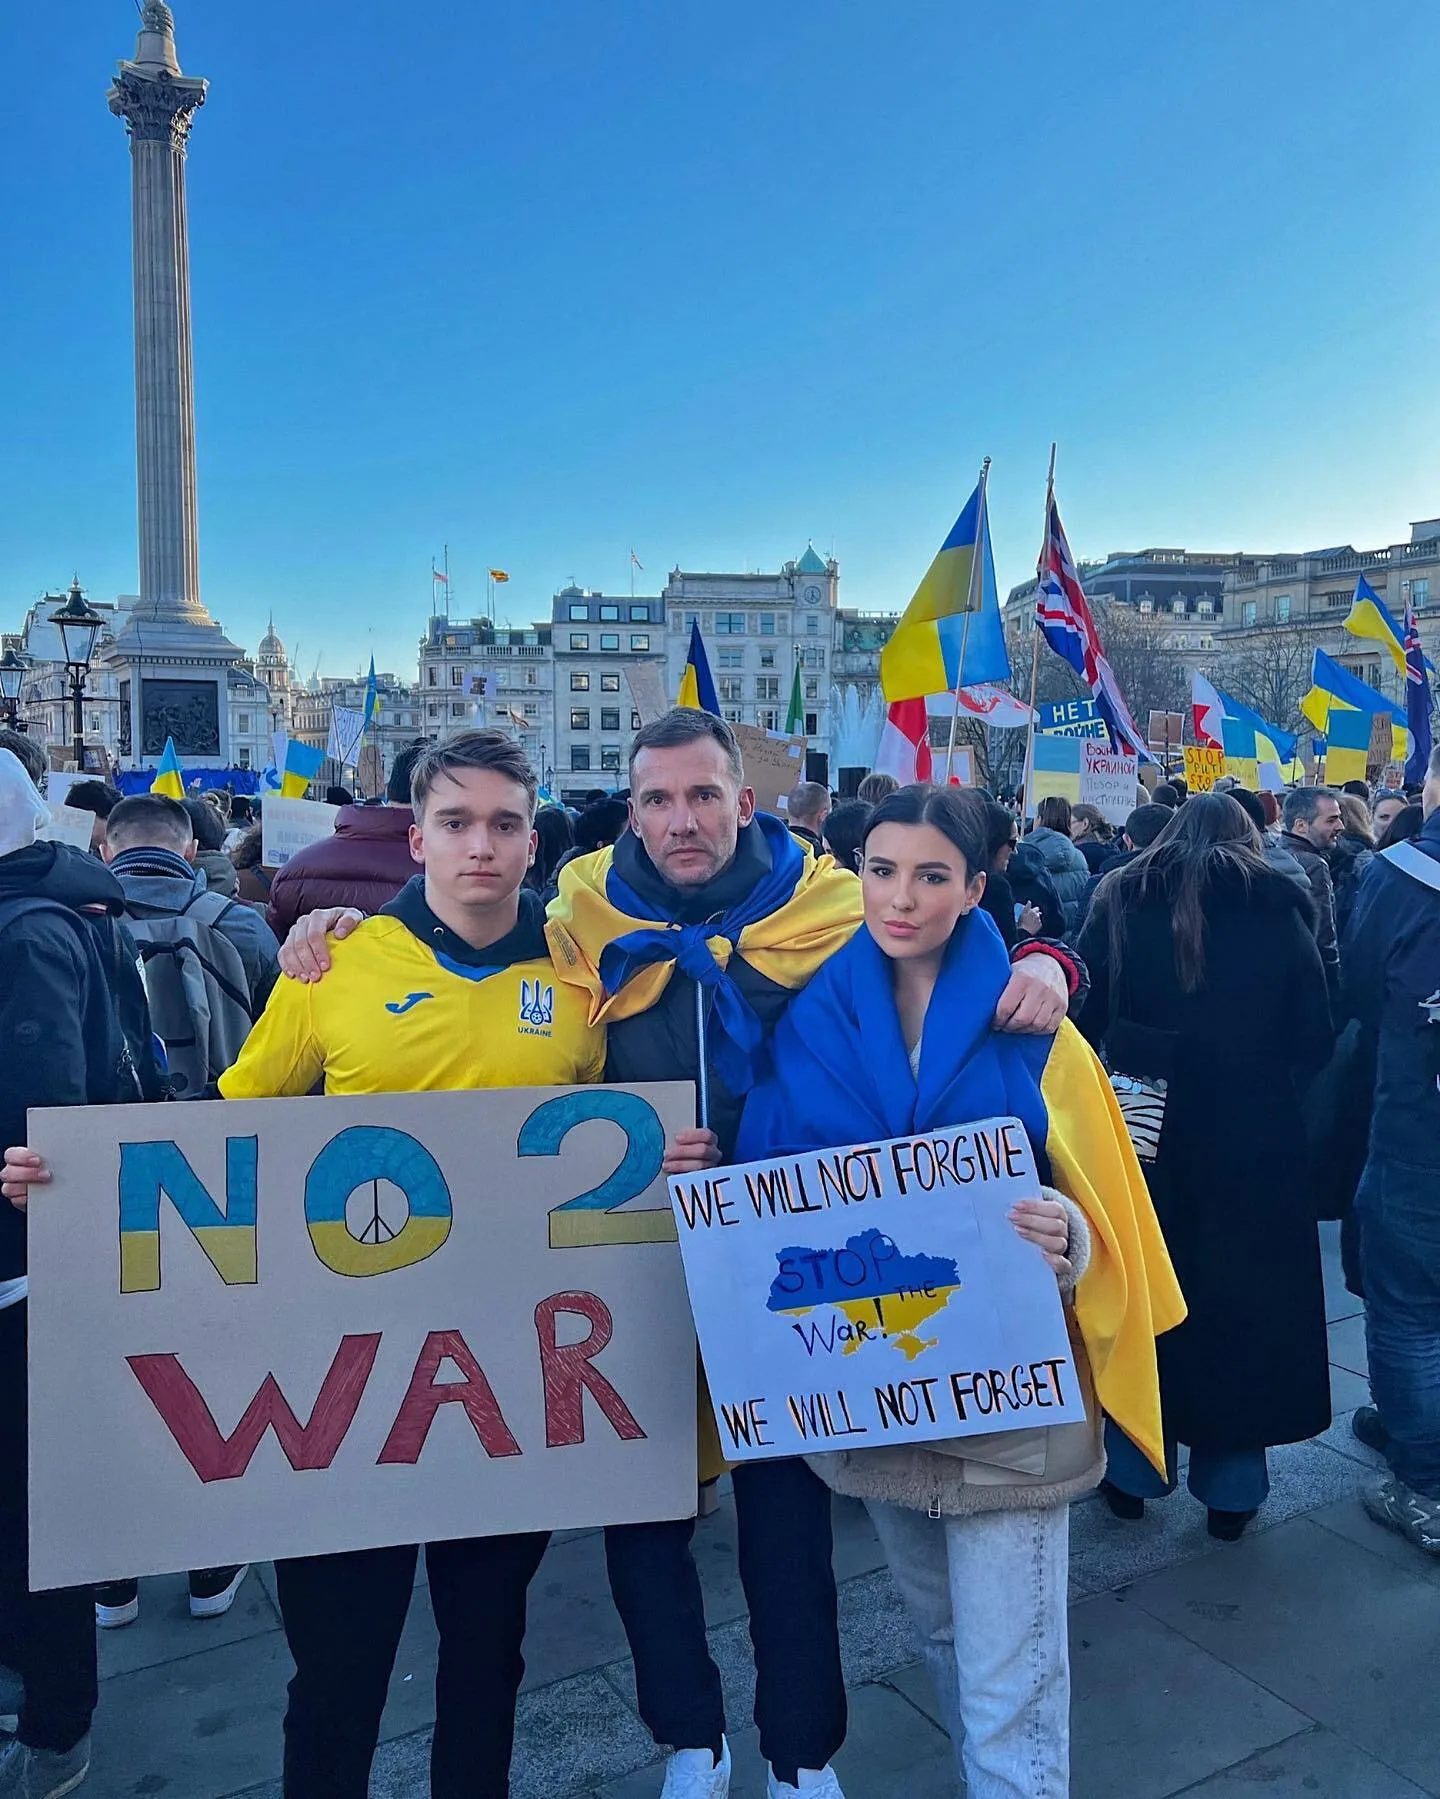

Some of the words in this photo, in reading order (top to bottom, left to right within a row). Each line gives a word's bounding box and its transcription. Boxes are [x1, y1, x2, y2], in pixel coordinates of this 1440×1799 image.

[1053, 700, 1096, 723] НЕТ
[1086, 743, 1113, 756] Войн
[1187, 747, 1224, 766] STOP
[1189, 774, 1211, 785] STO
[1194, 762, 1222, 774] PUTI
[518, 1026, 552, 1037] UKRAINE
[675, 1177, 740, 1230] WE
[744, 1163, 822, 1218] WILL
[817, 1147, 882, 1208] NOT
[890, 1125, 1025, 1194] FORGIVE
[119, 1125, 453, 1294] NO
[516, 1089, 679, 1248] 2
[774, 1234, 895, 1293] STOP
[894, 1279, 937, 1302] THE
[125, 1289, 648, 1484] WAR
[721, 1398, 775, 1449] WE
[788, 1390, 867, 1440] WILL
[874, 1378, 939, 1429] NOT
[950, 1359, 1066, 1420] FORGET
